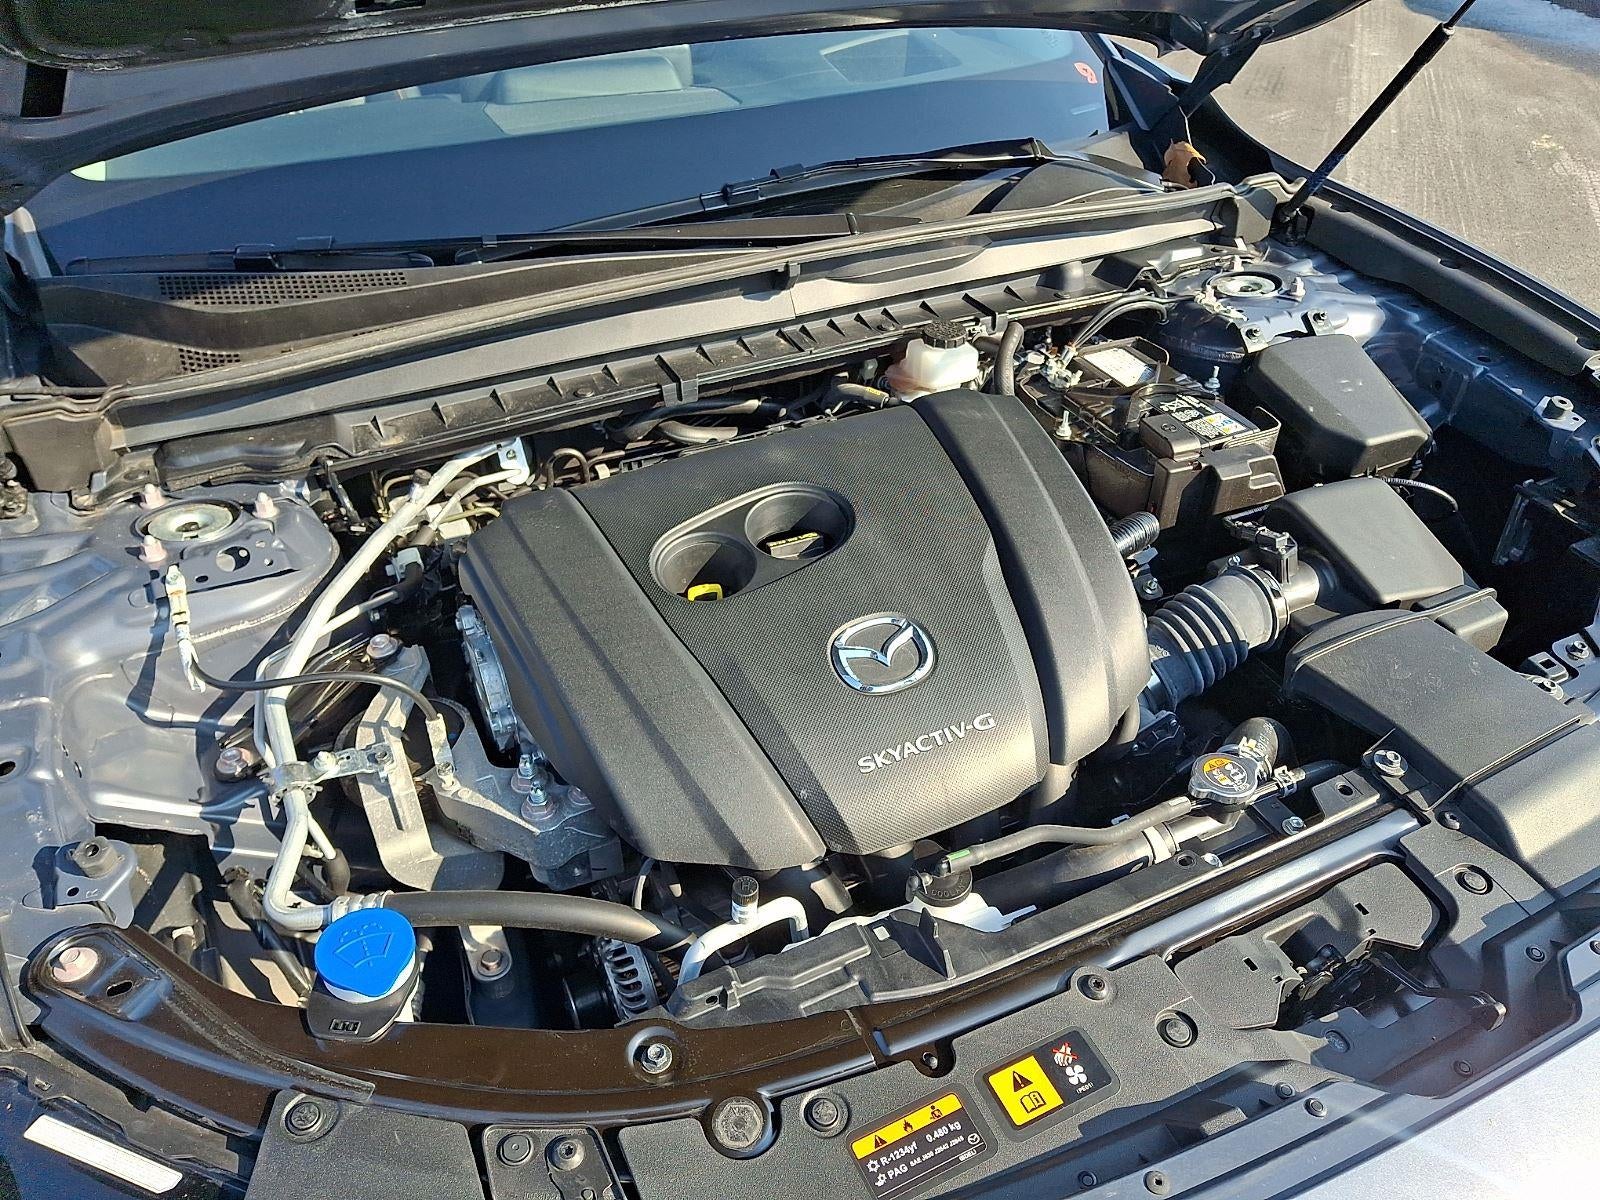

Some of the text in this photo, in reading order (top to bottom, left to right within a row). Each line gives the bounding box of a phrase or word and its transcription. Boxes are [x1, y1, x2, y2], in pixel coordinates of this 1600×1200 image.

[857, 712, 997, 774] SKYACTIV-G
[880, 1121, 962, 1167] R-1234yf 0.480 kg
[887, 1163, 909, 1180] PAG
